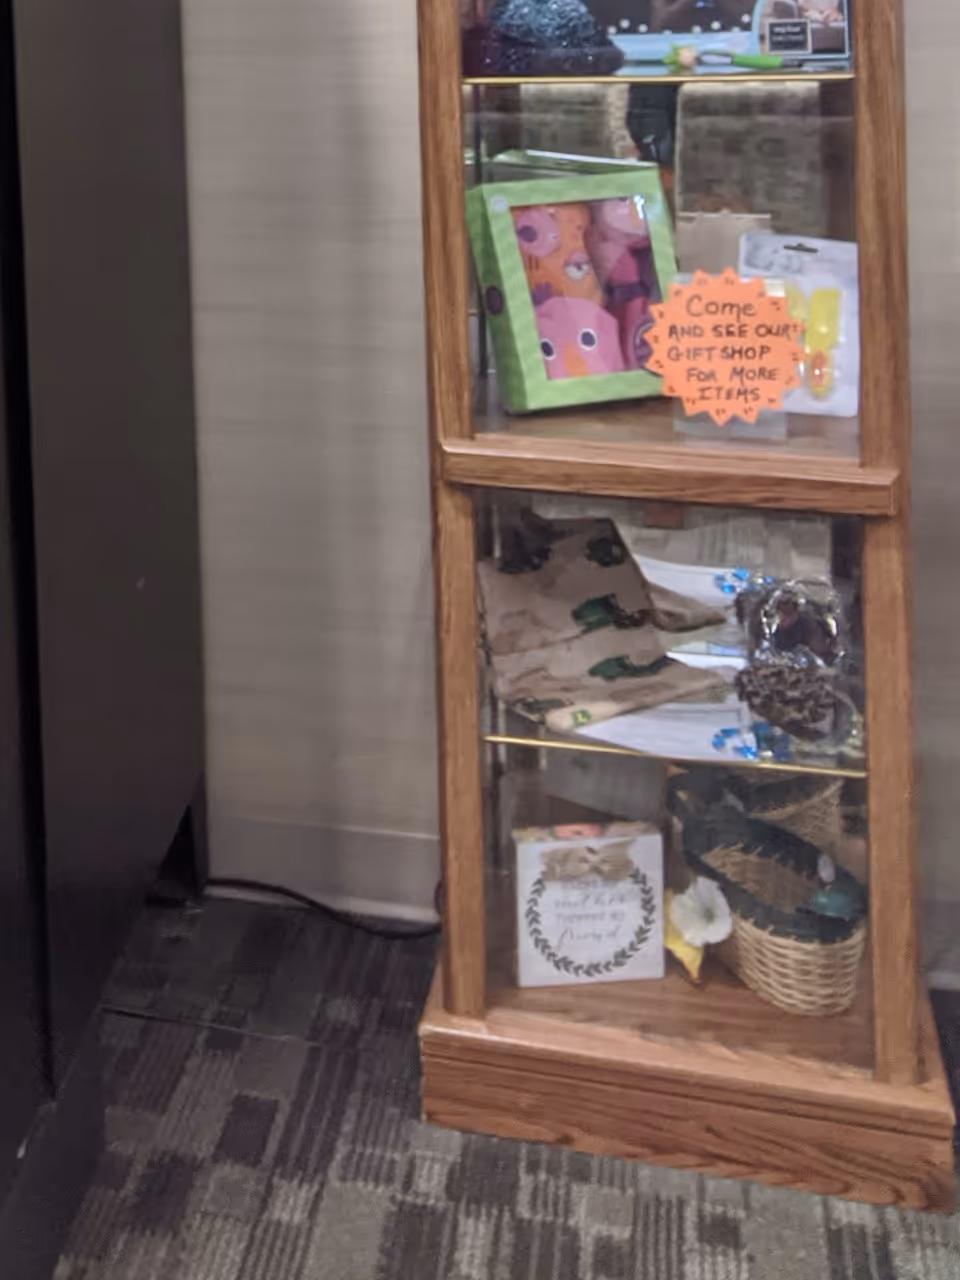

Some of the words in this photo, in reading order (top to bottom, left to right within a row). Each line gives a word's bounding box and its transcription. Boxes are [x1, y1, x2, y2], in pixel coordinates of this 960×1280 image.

[686, 294, 757, 323] Come
[668, 324, 704, 342] AND
[711, 324, 748, 338] SEE
[667, 346, 717, 362] GIFT
[720, 345, 771, 361] SHOP
[686, 367, 718, 382] FOR
[729, 366, 779, 386] MORE
[697, 387, 761, 403] ITEMS
